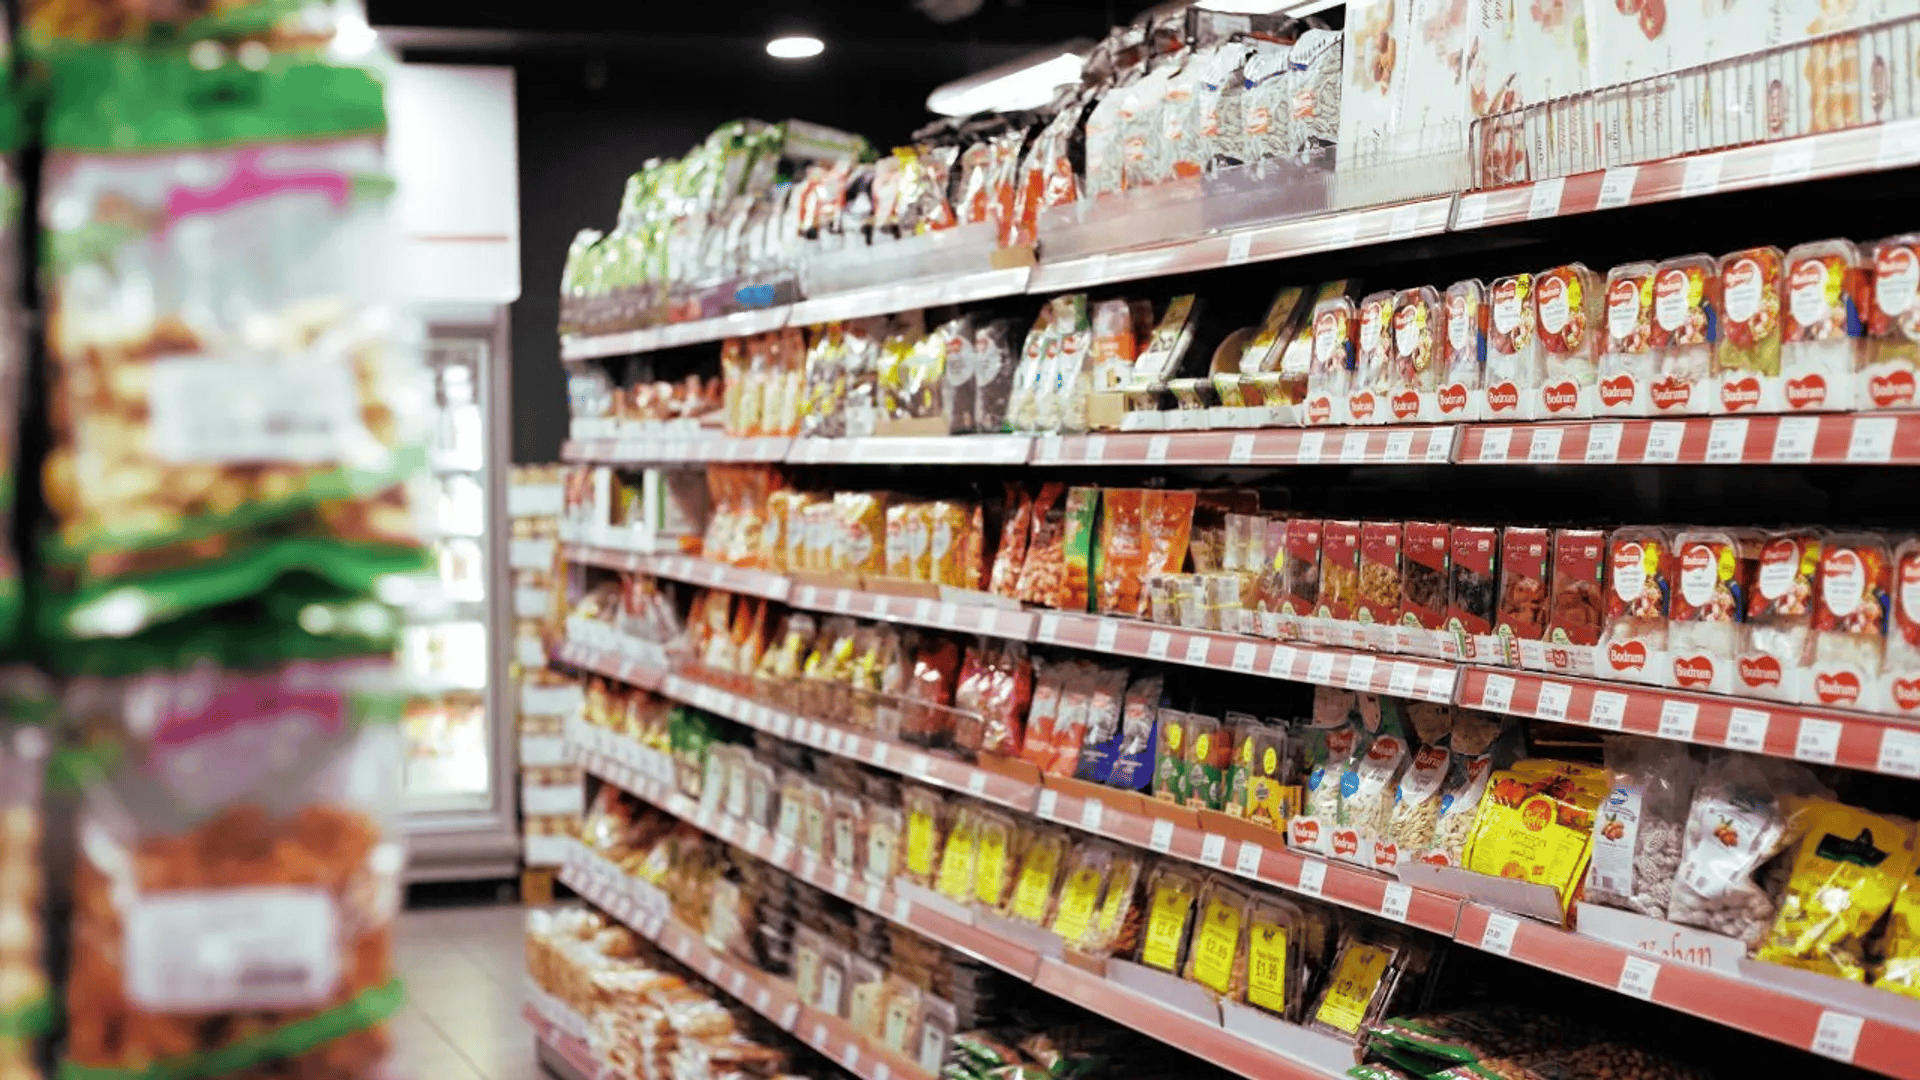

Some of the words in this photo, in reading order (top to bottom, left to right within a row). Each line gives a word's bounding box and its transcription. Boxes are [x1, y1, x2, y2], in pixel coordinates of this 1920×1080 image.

[1545, 391, 1576, 404] Bodrum
[1602, 386, 1633, 399] Bodrum
[1610, 649, 1645, 664] Bodrum
[1676, 662, 1712, 680] Bodrum
[1741, 663, 1780, 680] Bodrum
[1817, 677, 1858, 697] Bodrum
